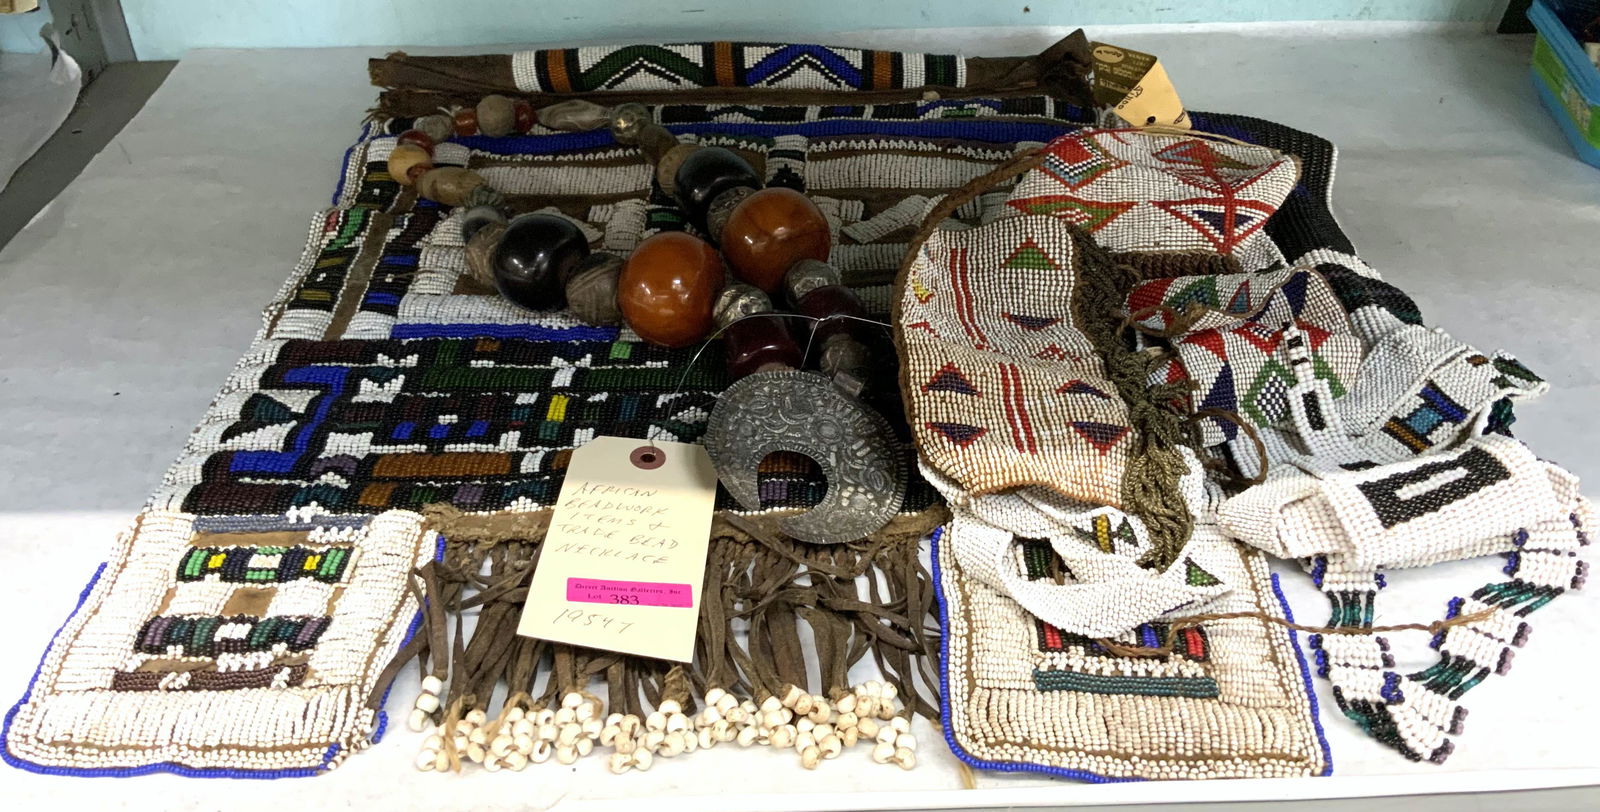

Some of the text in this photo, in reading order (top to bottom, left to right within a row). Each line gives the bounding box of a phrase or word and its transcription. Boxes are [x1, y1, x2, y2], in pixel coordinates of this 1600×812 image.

[571, 481, 658, 497] AFRICAN
[564, 498, 668, 516] BEADWORK
[570, 512, 637, 526] ITEMS
[556, 524, 679, 549] TRADE BEAD
[555, 543, 669, 564] NECKLACE
[610, 594, 640, 605] 383
